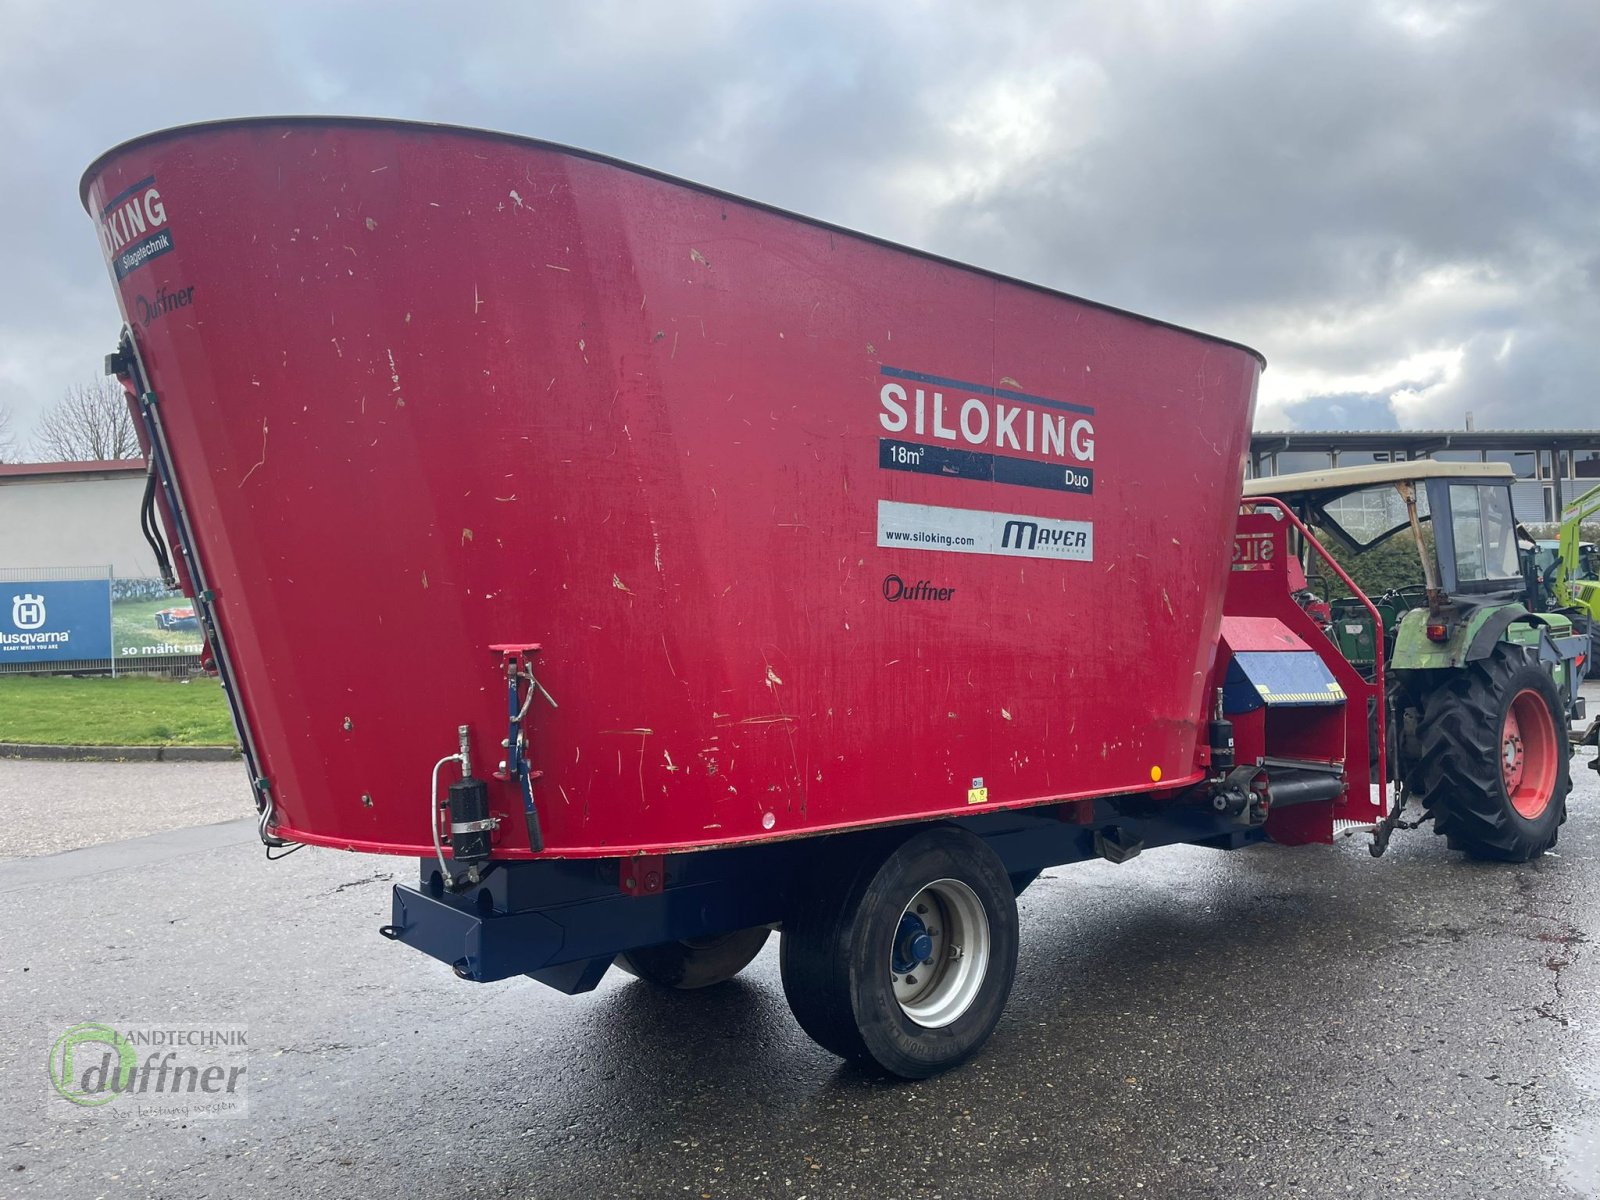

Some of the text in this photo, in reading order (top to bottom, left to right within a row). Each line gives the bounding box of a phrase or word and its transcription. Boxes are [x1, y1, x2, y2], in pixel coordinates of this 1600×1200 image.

[101, 188, 168, 260] OKING
[122, 234, 169, 269] Silagetechnik
[136, 285, 194, 327] Duffner
[879, 383, 1095, 462] SILOKING
[1065, 470, 1089, 488] Duo
[886, 520, 1087, 549] www.siloking.com MAYER
[882, 573, 956, 603] Duffner
[0, 631, 69, 645] usqvarna
[122, 643, 205, 655] so mäht ma
